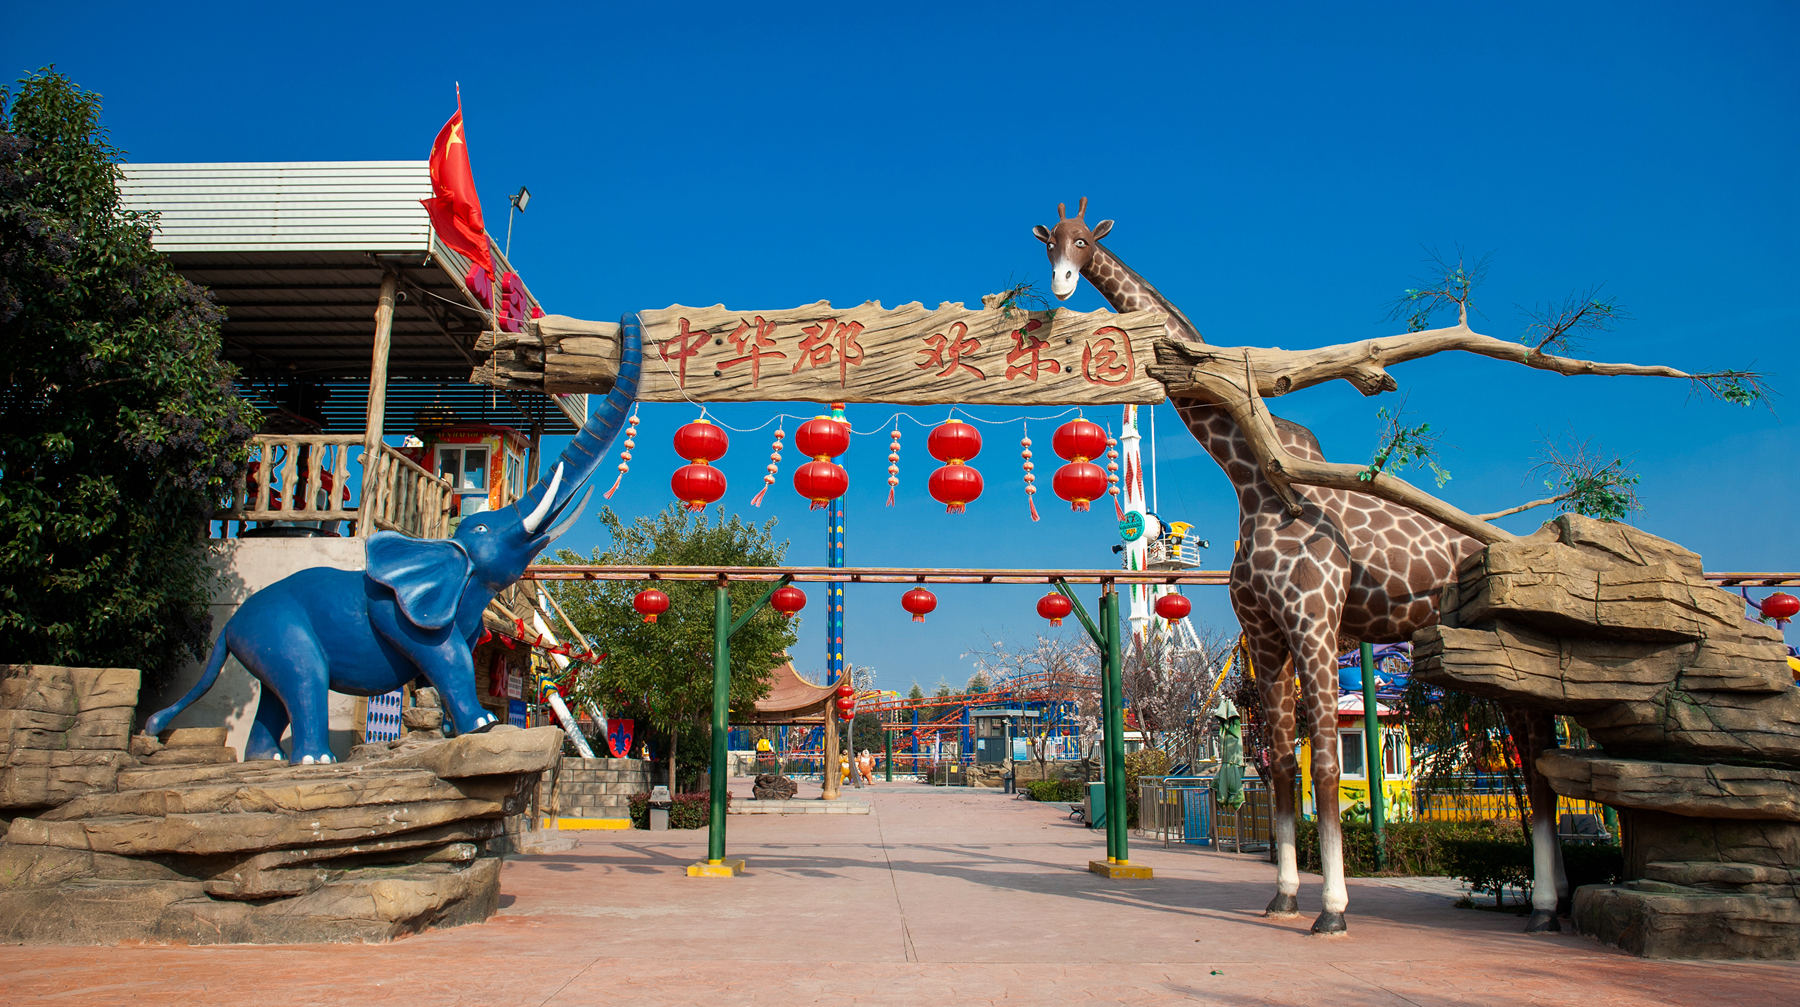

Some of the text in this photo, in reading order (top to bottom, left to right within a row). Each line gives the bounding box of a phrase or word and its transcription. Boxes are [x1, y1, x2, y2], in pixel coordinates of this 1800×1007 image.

[659, 315, 1135, 389] 中华郡 欢乐园
